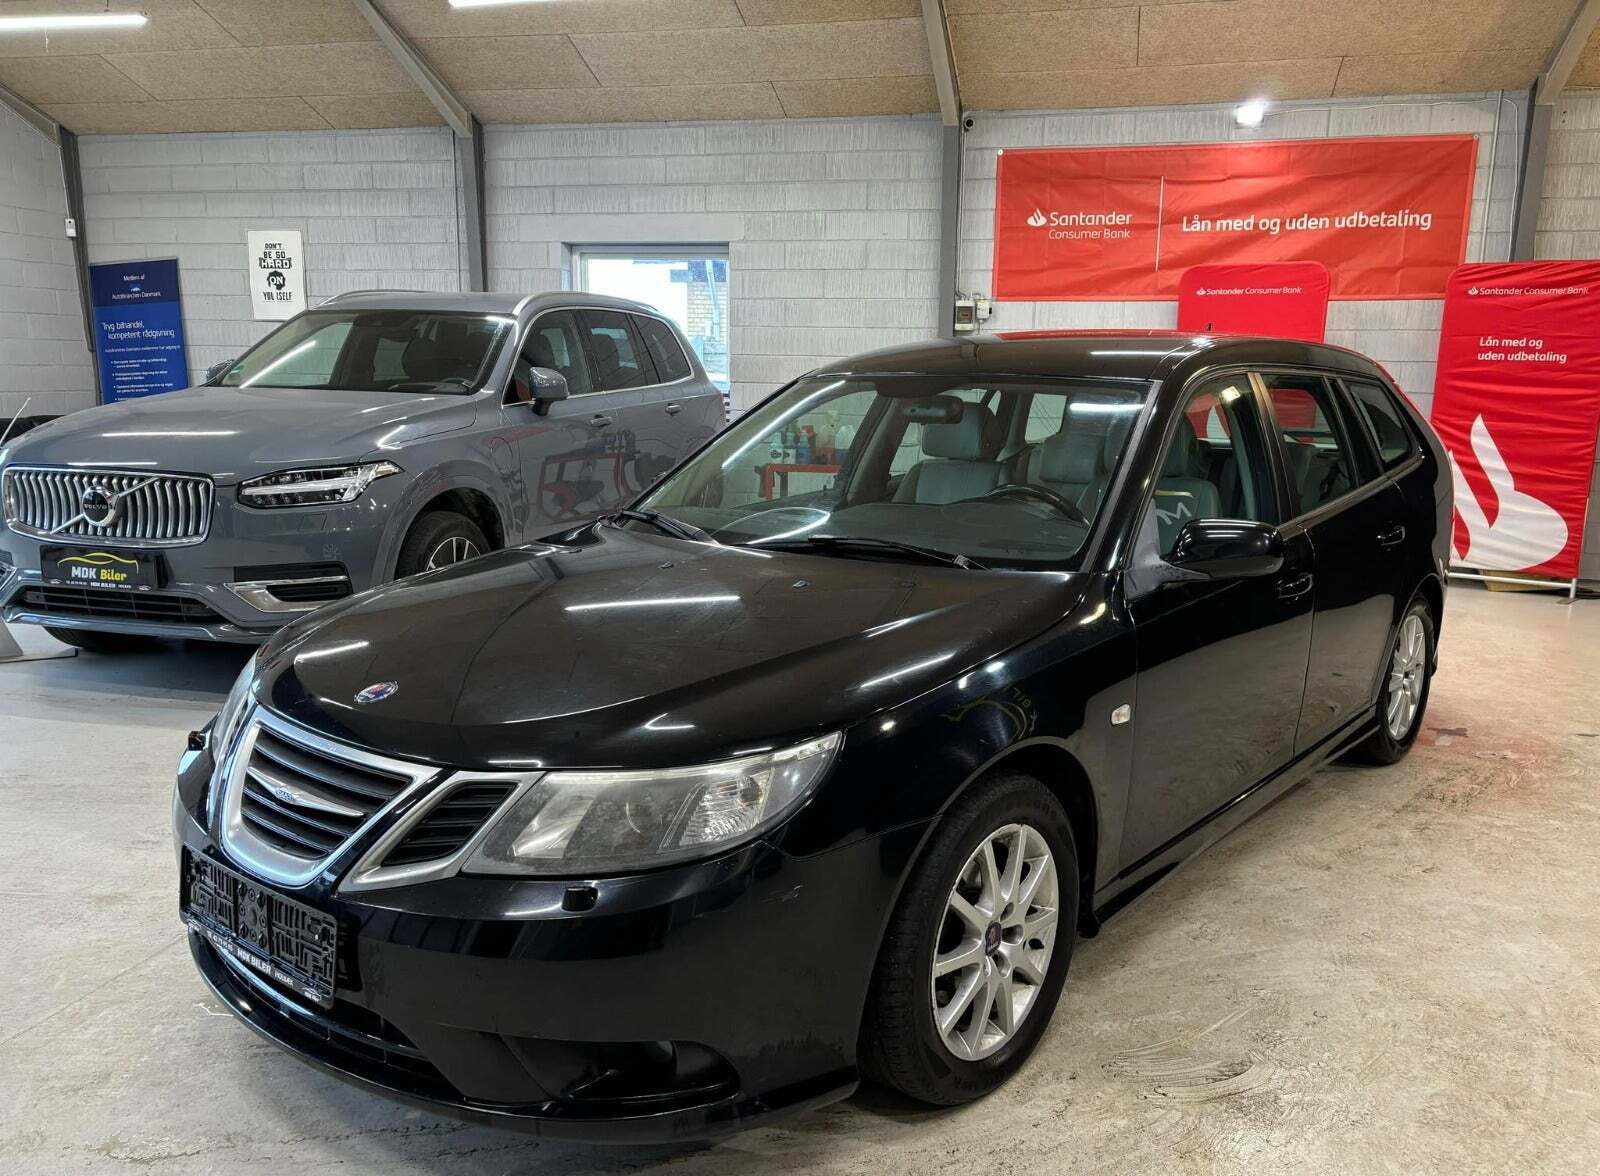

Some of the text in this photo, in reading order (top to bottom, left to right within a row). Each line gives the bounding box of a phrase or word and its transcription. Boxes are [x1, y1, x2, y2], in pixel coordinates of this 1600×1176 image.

[1049, 211, 1133, 227] Santander
[1182, 209, 1432, 235] Lån med og uden udbetaling
[1048, 228, 1131, 240] Consumer Bank
[260, 259, 291, 269] HARD
[270, 276, 284, 285] ON
[1206, 286, 1302, 295] Santander Consumer Bank
[1479, 286, 1590, 295] Santander Consumer Bank
[1479, 336, 1543, 349] Lån med og
[1477, 351, 1567, 364] uden udbetaling
[71, 566, 128, 581] MDK Biler
